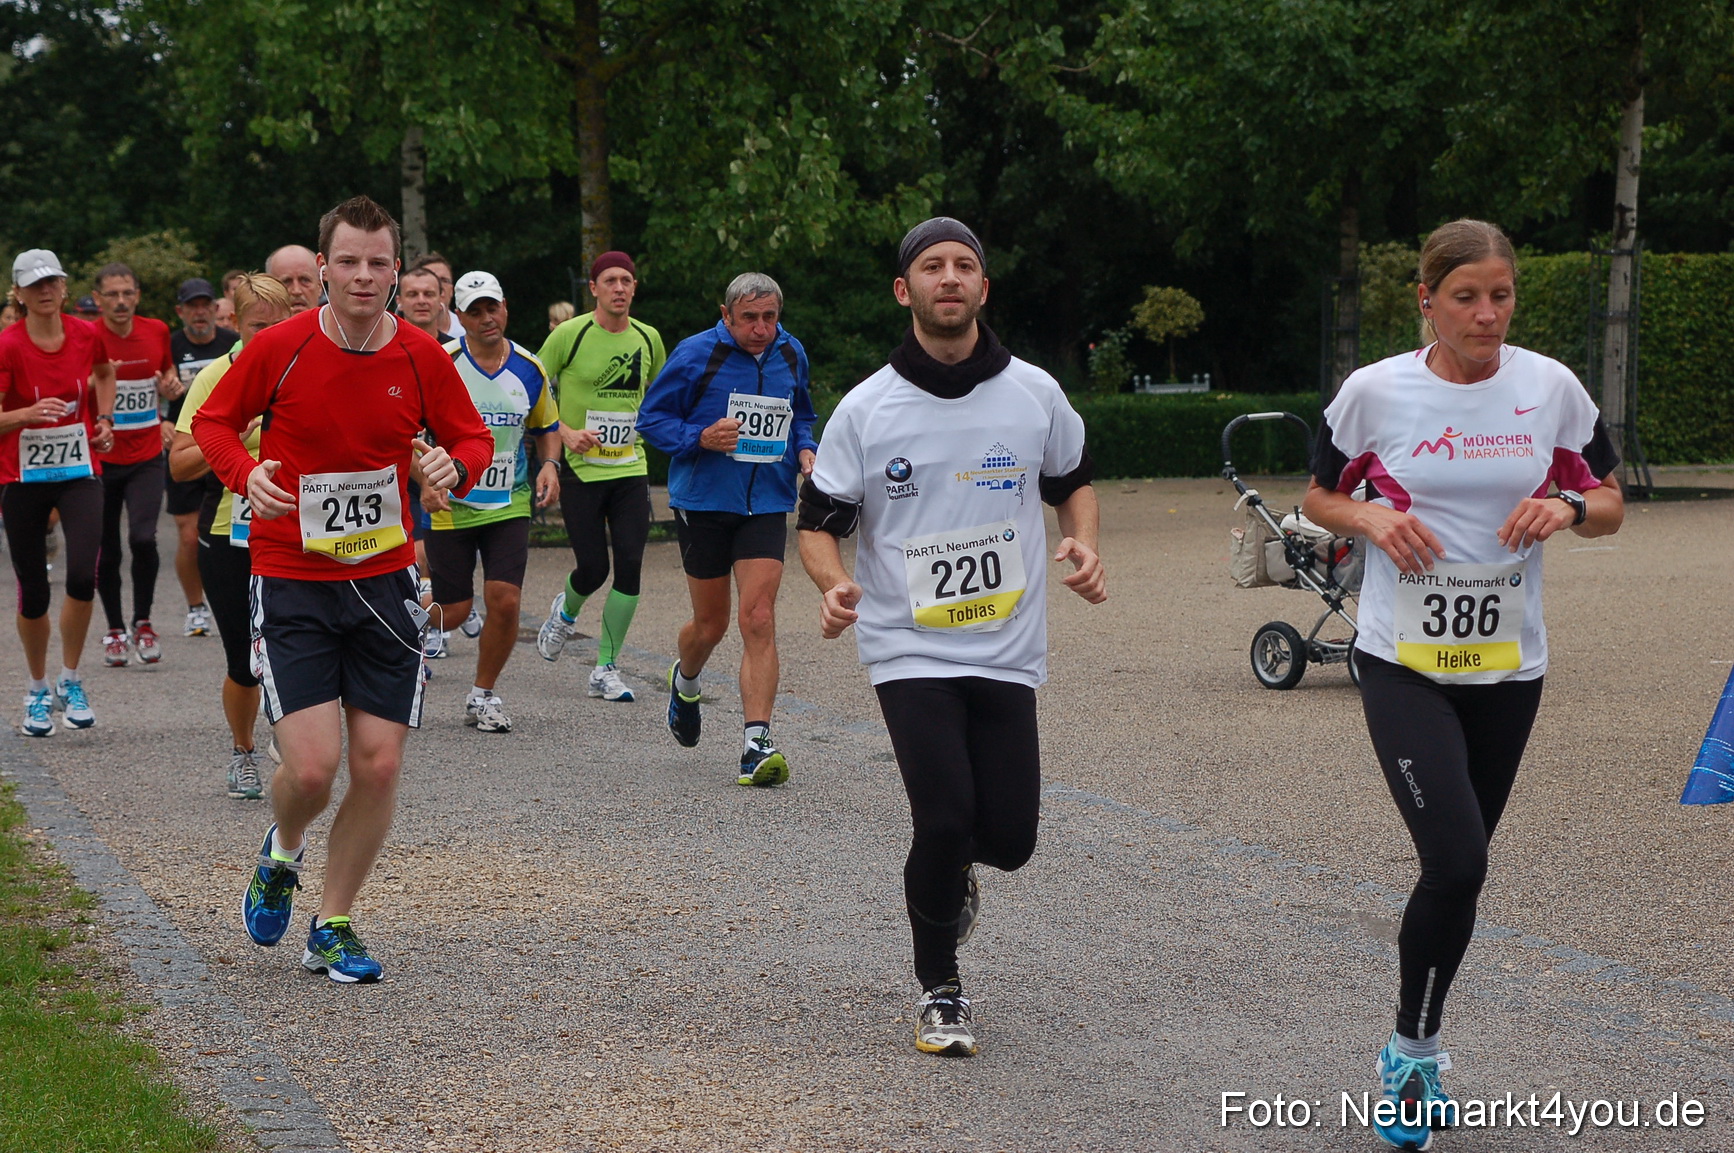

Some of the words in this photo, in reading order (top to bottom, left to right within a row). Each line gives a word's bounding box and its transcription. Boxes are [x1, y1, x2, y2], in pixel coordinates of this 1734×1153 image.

[593, 361, 619, 387] GOSSEN
[115, 390, 155, 411] 2687
[596, 391, 638, 399] METRAWATT
[730, 400, 753, 409] PARTL
[754, 402, 785, 411] Neumarkt
[597, 424, 631, 445] 302
[735, 411, 787, 437] 2987
[741, 442, 774, 453] Richard
[1463, 434, 1532, 447] MÜNCHEN
[28, 440, 82, 465] 2274
[1463, 447, 1534, 460] MARATHON
[302, 483, 336, 494] PARTL
[338, 479, 385, 492] Neumarkt
[886, 483, 919, 494] PARTL
[322, 493, 383, 533] 243
[334, 537, 378, 555] Florian
[906, 544, 944, 559] PARTL
[946, 534, 999, 553] Neumarkt
[931, 551, 1002, 600] 220
[1398, 573, 1443, 587] PARTL
[1446, 576, 1505, 588] Neumarkt
[947, 603, 996, 624] Tobias
[1422, 593, 1501, 639] 386
[1436, 650, 1481, 668] Heike
[1405, 771, 1425, 809] odlo
